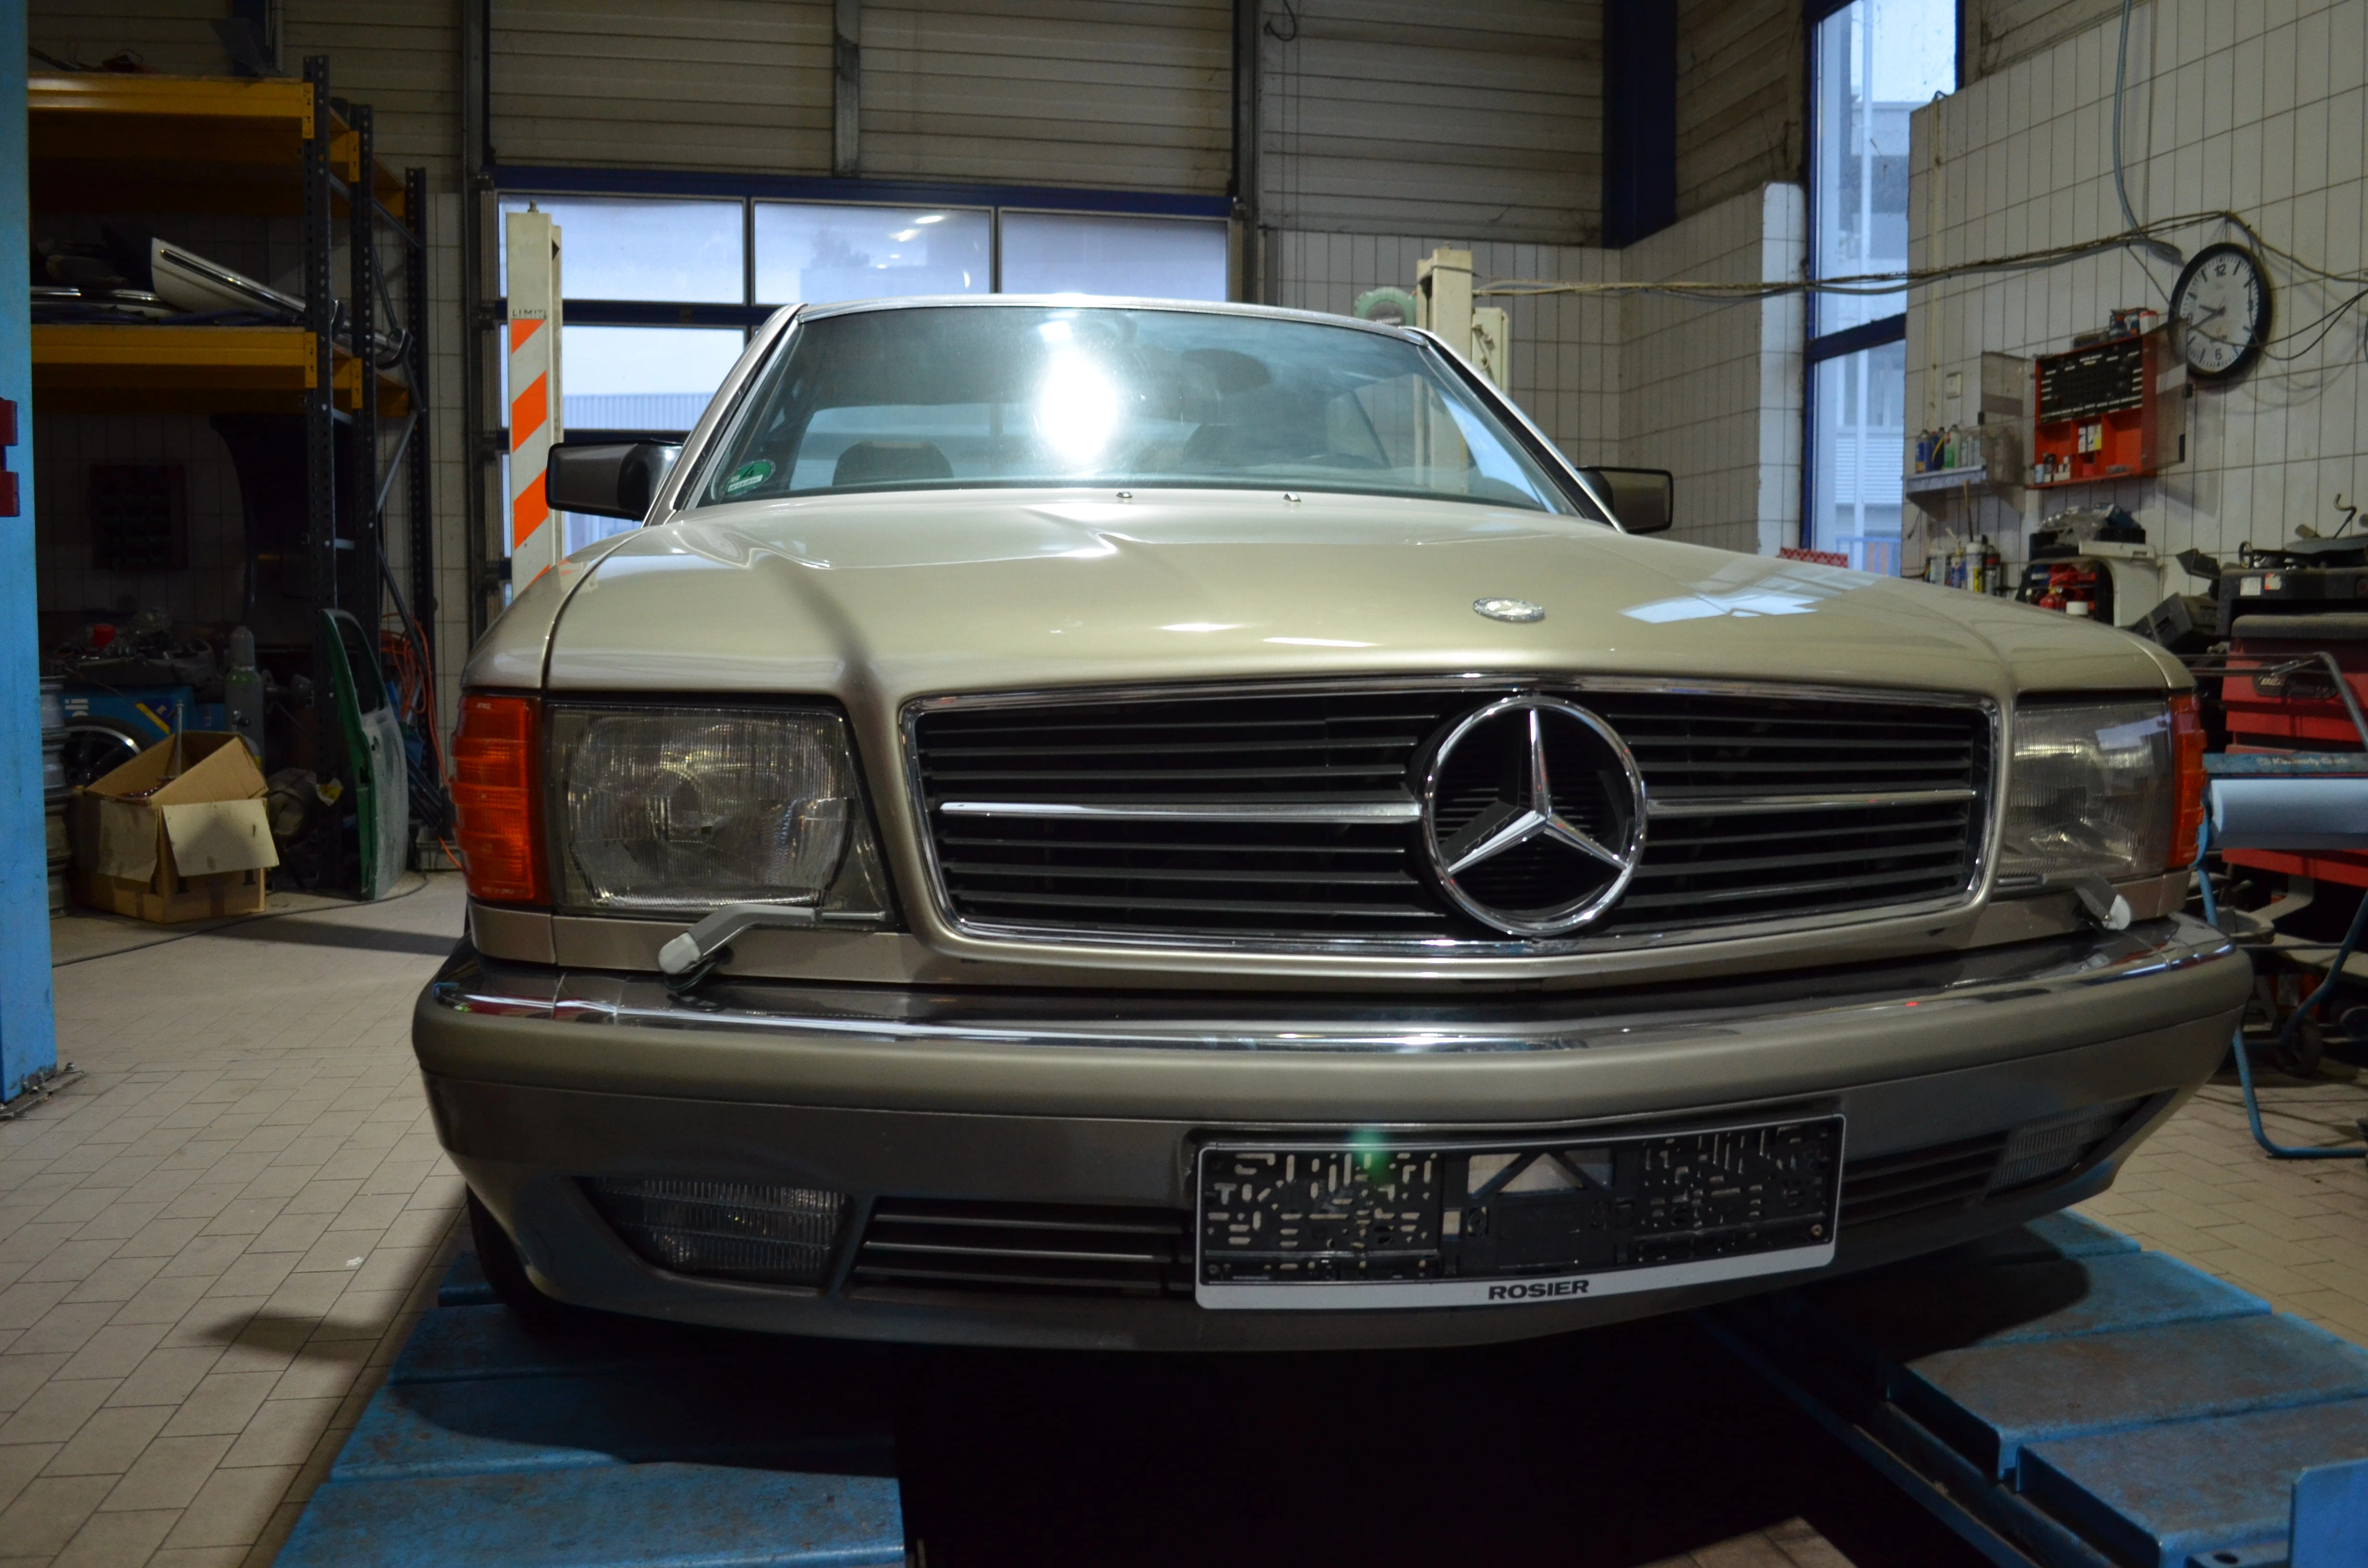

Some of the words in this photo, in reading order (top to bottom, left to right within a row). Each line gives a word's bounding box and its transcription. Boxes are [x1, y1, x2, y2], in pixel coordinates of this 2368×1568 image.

[2214, 264, 2226, 277] 12
[2215, 348, 2221, 361] 6
[742, 465, 754, 478] 4
[1489, 1280, 1589, 1300] ROSIER
